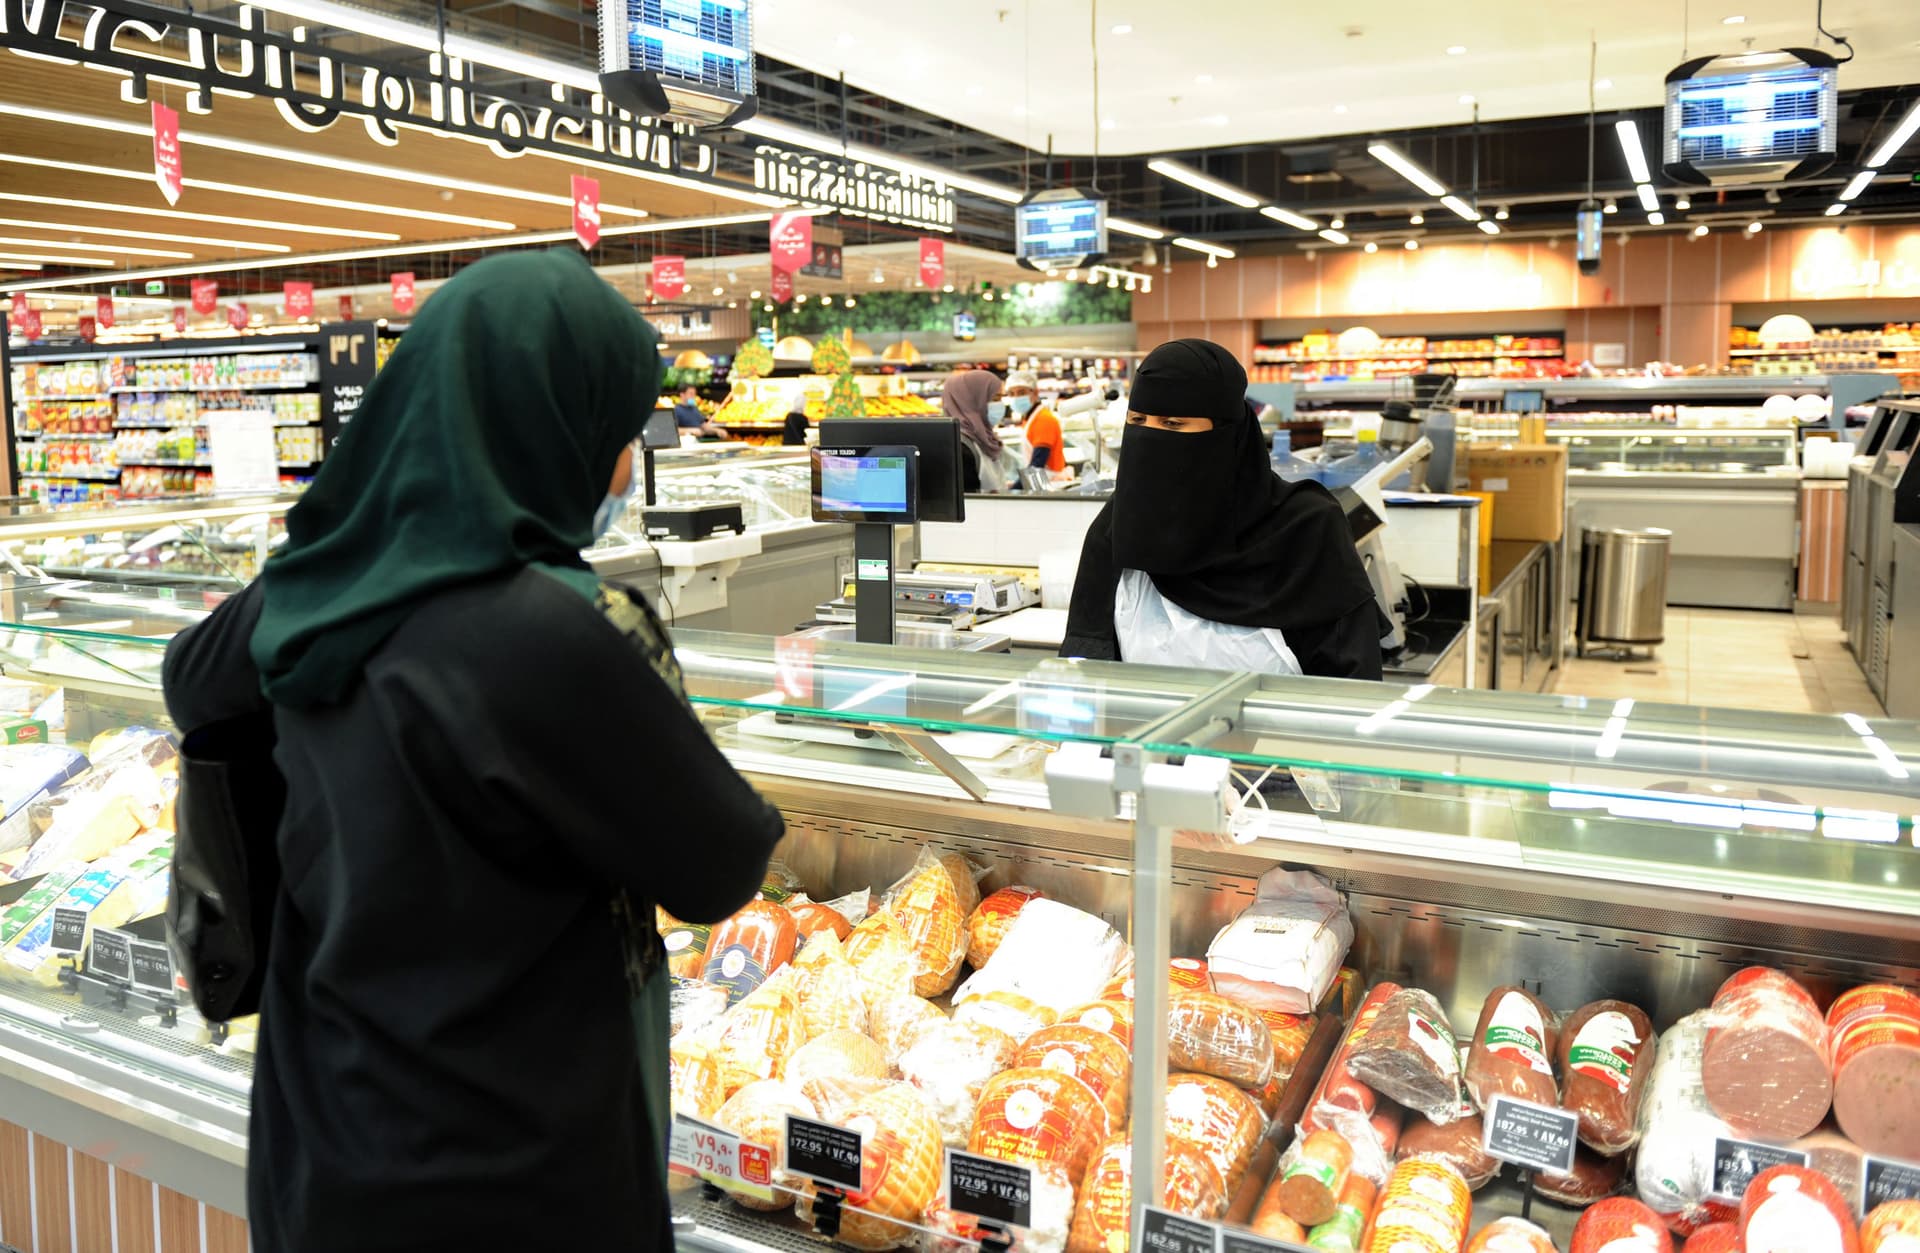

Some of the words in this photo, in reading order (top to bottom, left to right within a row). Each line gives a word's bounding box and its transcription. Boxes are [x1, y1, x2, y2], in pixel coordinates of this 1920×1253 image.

[332, 398, 365, 413] لفطور
[795, 1138, 822, 1153] 72.95
[695, 1152, 732, 1177] 79.90
[959, 1175, 988, 1192] 72.95
[1151, 1232, 1182, 1252] 62.95
